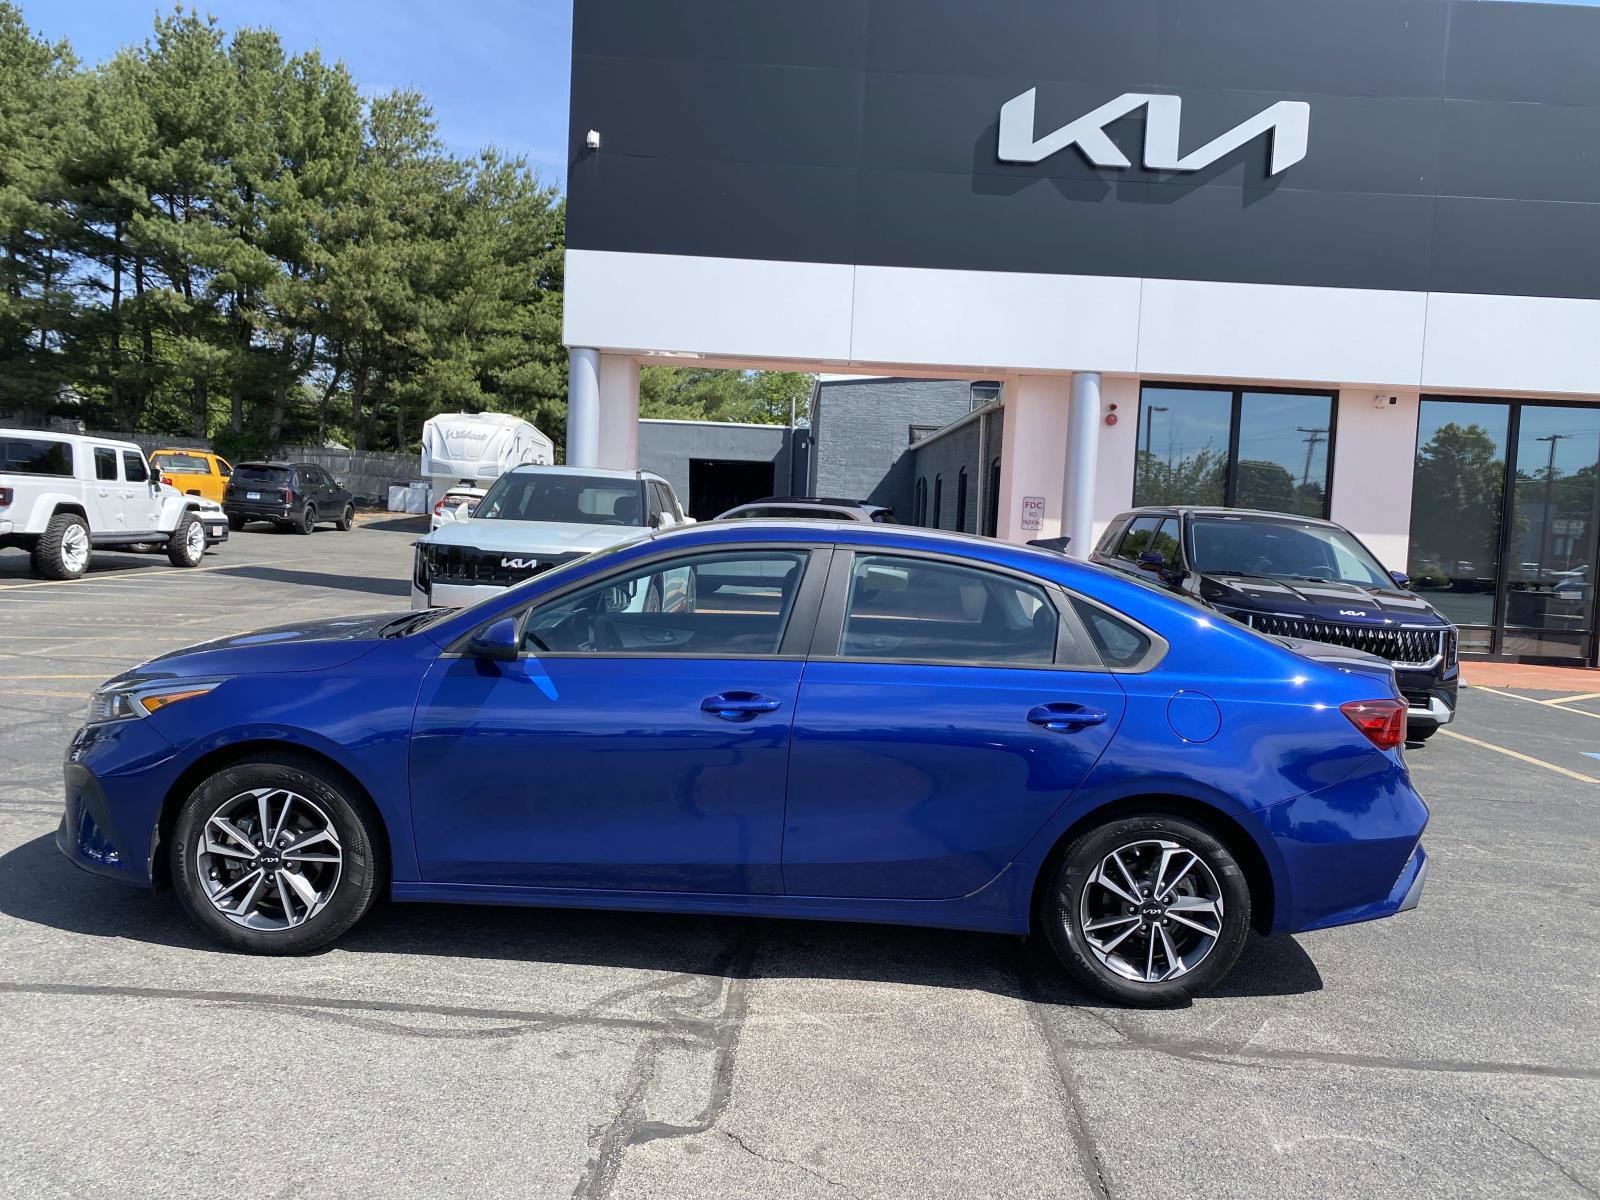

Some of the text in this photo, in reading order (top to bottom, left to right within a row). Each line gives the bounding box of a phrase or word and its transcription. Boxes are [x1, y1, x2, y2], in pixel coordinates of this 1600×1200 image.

[998, 87, 1311, 176] KIA
[446, 430, 488, 441] Wildcat
[1025, 501, 1042, 509] FDC
